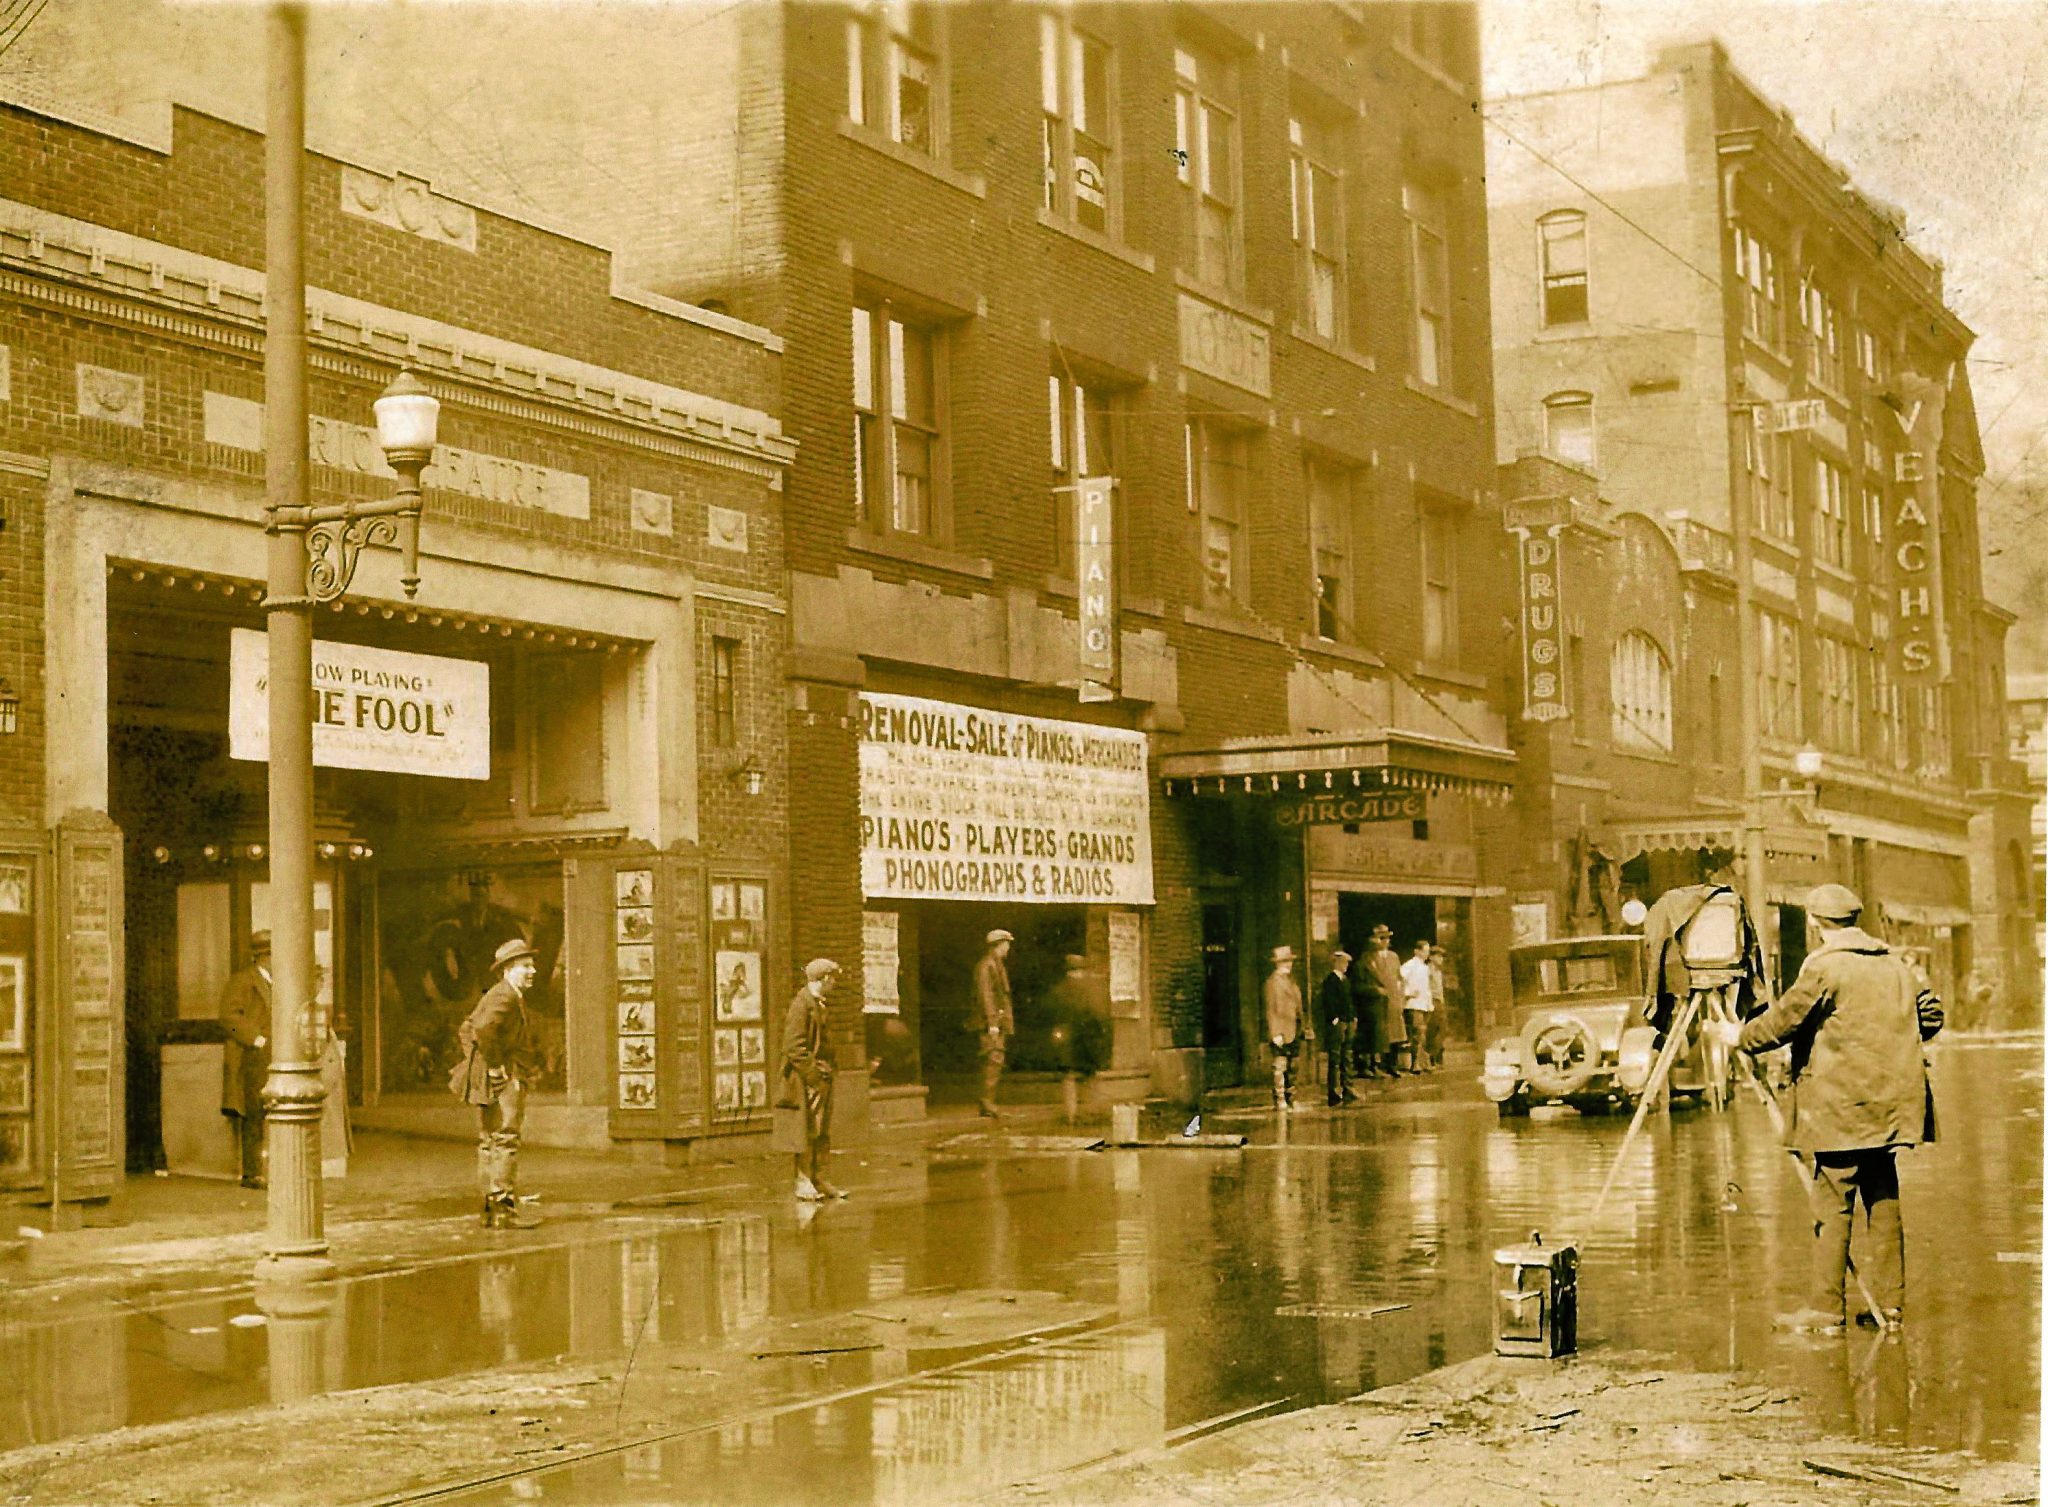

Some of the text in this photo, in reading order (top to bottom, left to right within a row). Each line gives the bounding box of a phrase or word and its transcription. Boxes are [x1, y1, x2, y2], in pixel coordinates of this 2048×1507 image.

[1086, 491, 1106, 652] PIANO
[1528, 540, 1557, 698] DRUGS
[1295, 797, 1420, 824] ARCADE
[860, 814, 1135, 863] PIANO'S PLAYERS GRANDS
[885, 857, 1027, 895] PHONOGRAPHS
[1031, 863, 1046, 896] &
